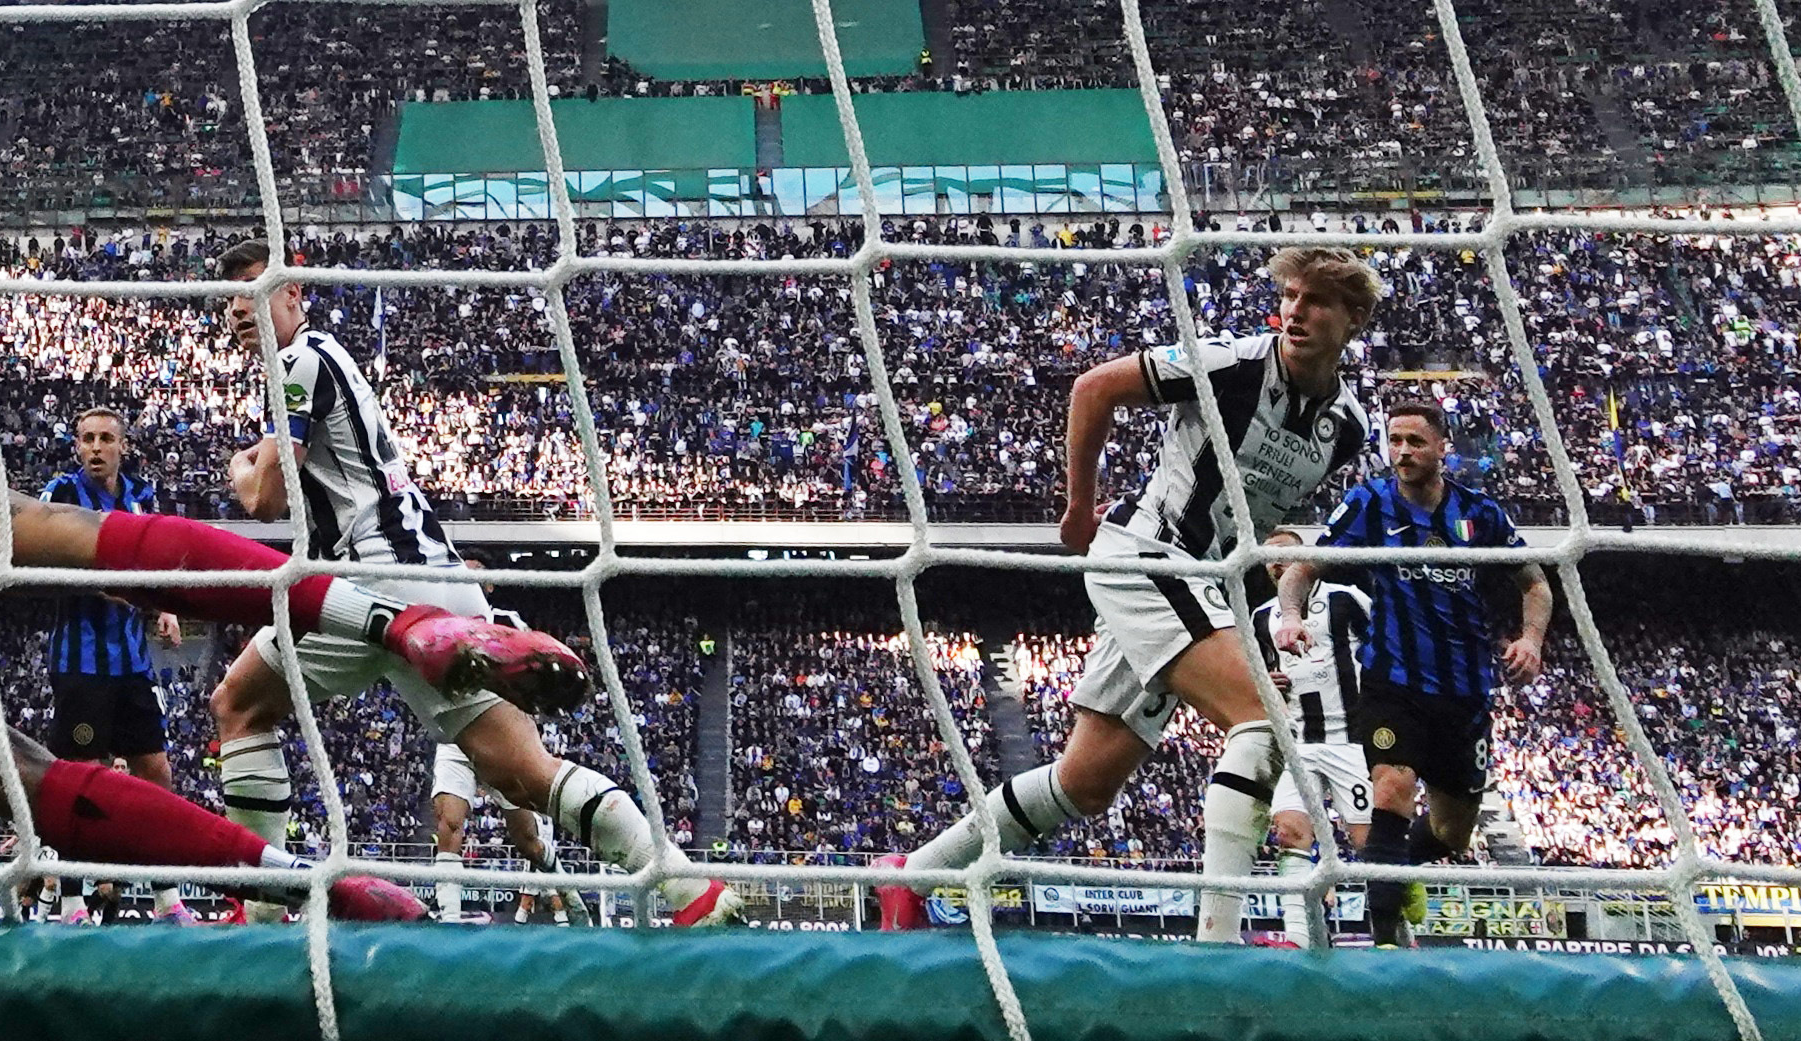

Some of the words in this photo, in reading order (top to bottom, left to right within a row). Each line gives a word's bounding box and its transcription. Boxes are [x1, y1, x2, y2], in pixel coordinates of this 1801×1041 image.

[1258, 442, 1295, 468] FRIULI
[1264, 426, 1280, 442] IO
[1282, 435, 1319, 464] SONO
[1244, 472, 1282, 497] GIULIA
[1254, 456, 1302, 490] VENEZIA
[1397, 564, 1476, 583] betsson
[1475, 738, 1488, 770] 8
[1351, 784, 1369, 811] 8
[1085, 890, 1114, 900] INTER
[1118, 891, 1144, 900] CLUB
